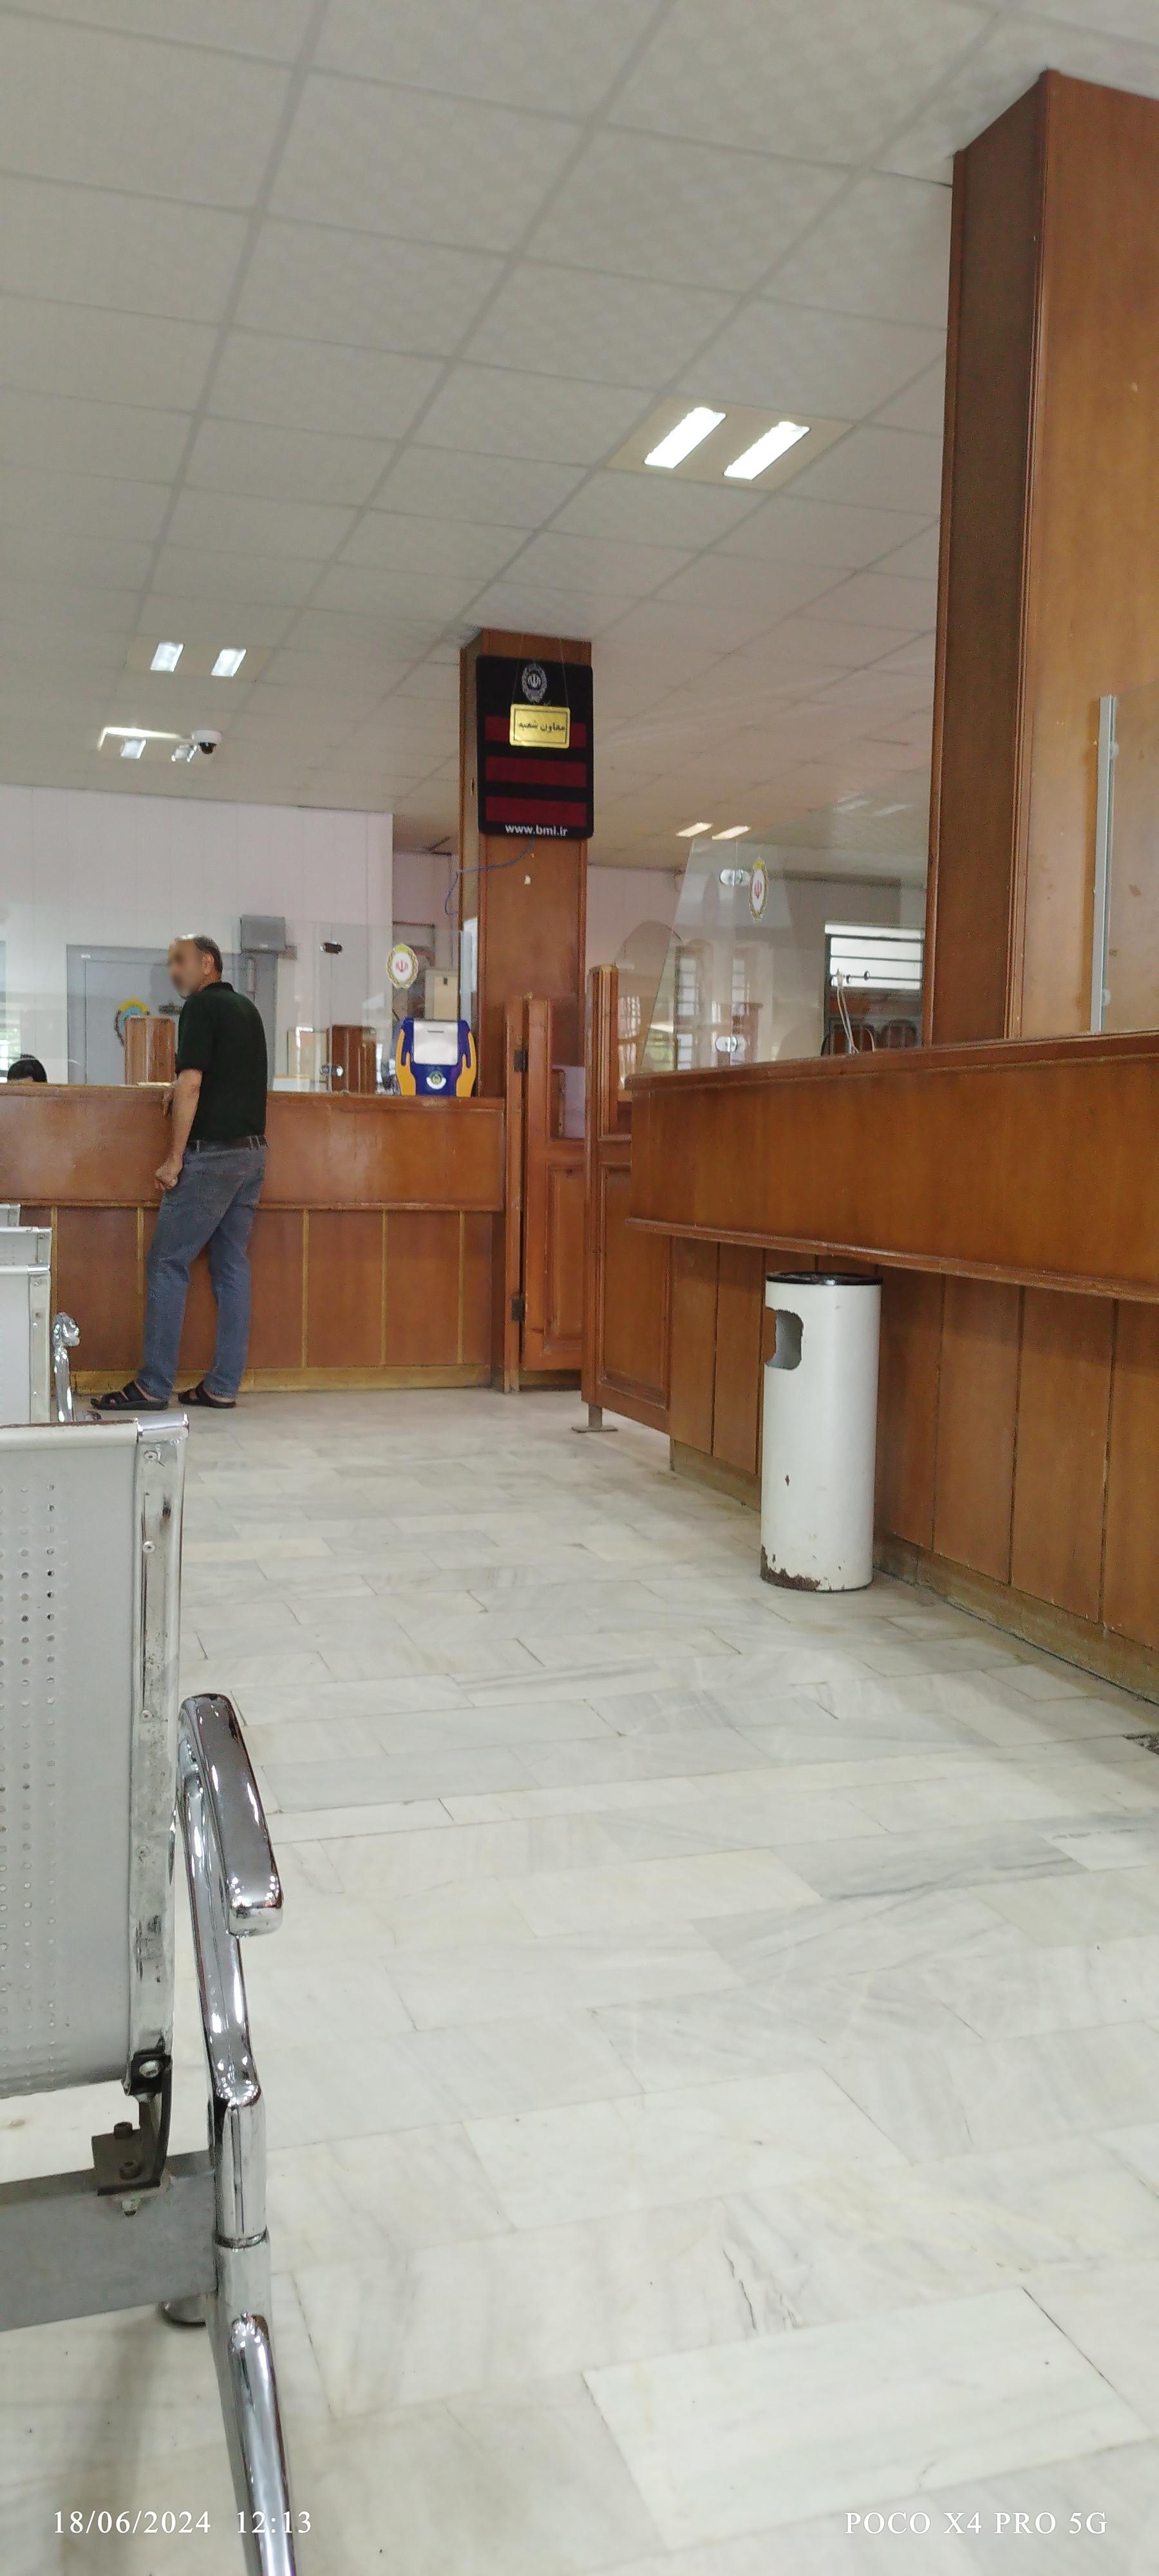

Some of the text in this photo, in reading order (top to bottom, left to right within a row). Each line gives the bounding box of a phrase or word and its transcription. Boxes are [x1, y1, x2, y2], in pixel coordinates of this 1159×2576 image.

[518, 719, 566, 733] معاون شعبه
[505, 824, 568, 837] www.bmi.ir
